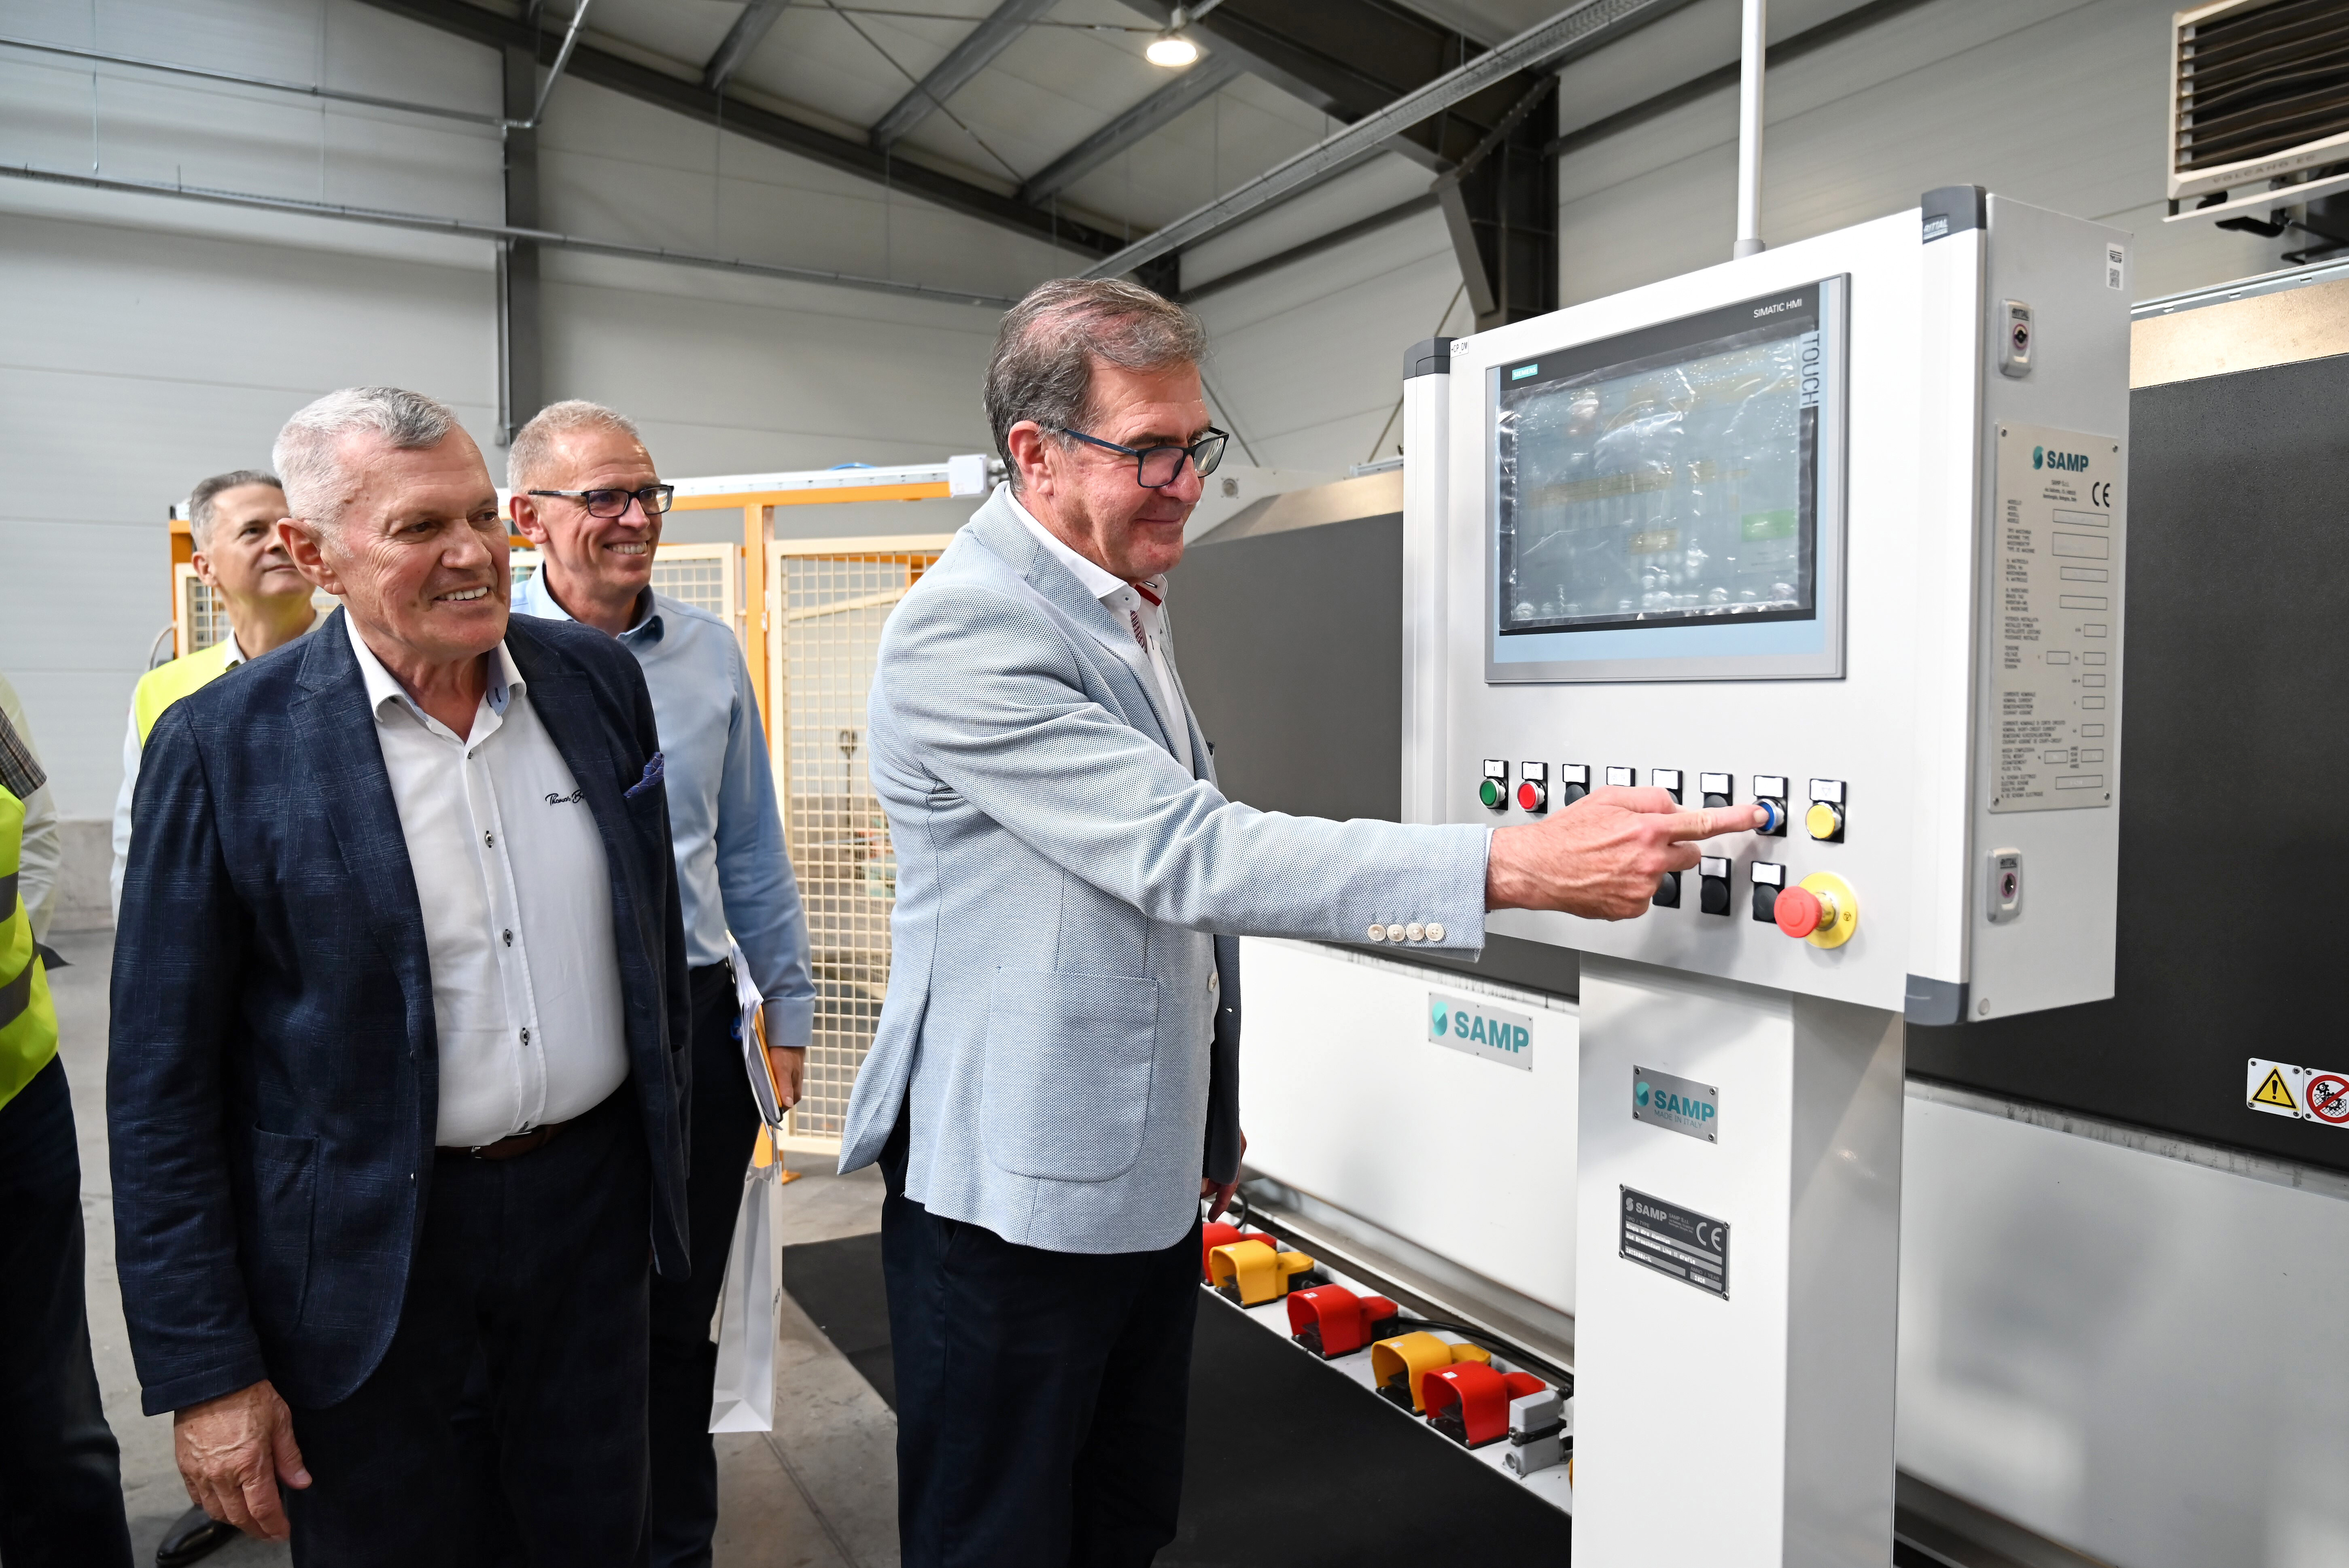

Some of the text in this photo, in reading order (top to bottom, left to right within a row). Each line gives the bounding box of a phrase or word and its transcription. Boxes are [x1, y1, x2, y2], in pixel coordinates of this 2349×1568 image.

[1753, 299, 1802, 318] SIMATIC HMI
[1513, 366, 1536, 378] SIEMENS
[1802, 333, 1819, 405] TOUCH
[2047, 450, 2089, 472] SAMP
[1454, 1011, 1529, 1053] SAMP
[1654, 1090, 1715, 1121] SAMP
[1654, 1109, 1702, 1129] MADE IN ITALY
[1636, 1202, 1667, 1221] SAMP
